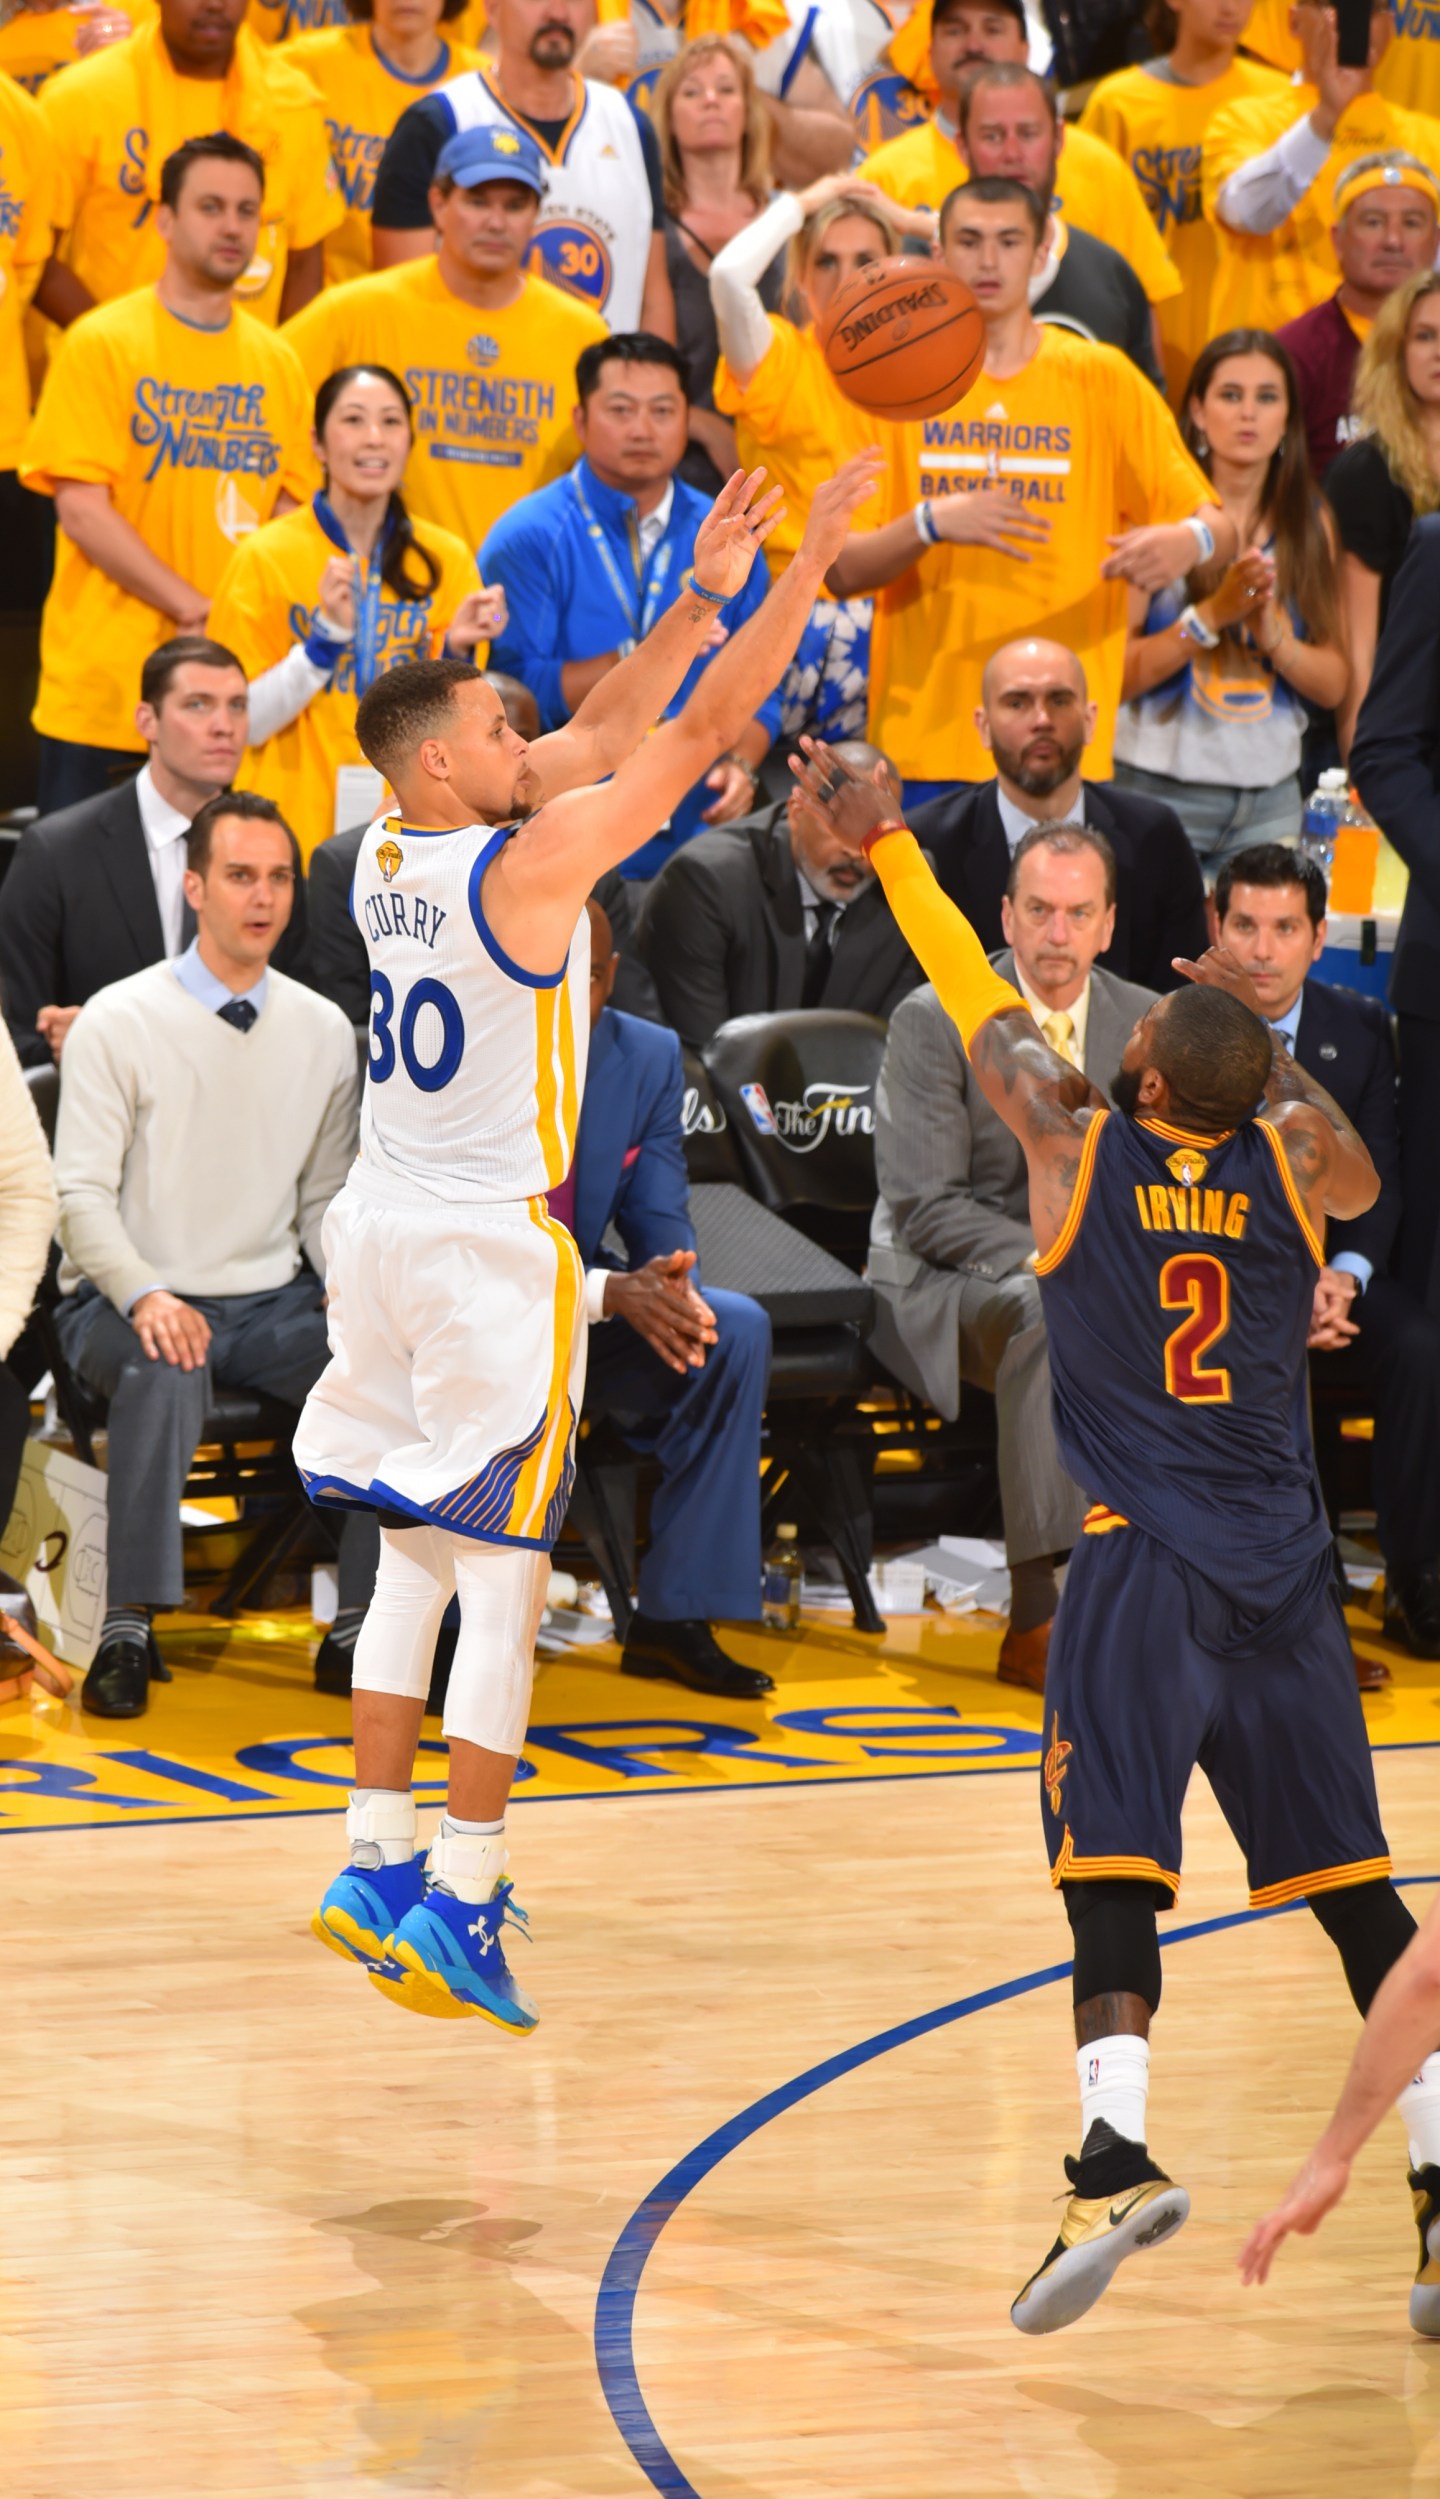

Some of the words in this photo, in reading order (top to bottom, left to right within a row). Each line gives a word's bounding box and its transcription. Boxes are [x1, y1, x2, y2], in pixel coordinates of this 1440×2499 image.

[560, 241, 599, 277] 30
[839, 281, 948, 352] SPALDING
[405, 366, 555, 420] STRENGTH
[445, 412, 539, 445] NUMBERS
[924, 420, 1071, 452] WARRIORS
[365, 892, 447, 949] CURRY
[369, 969, 465, 1092] 30
[775, 1101, 816, 1136] The
[1134, 1184, 1251, 1240] IRVING
[1159, 1252, 1233, 1406] 2
